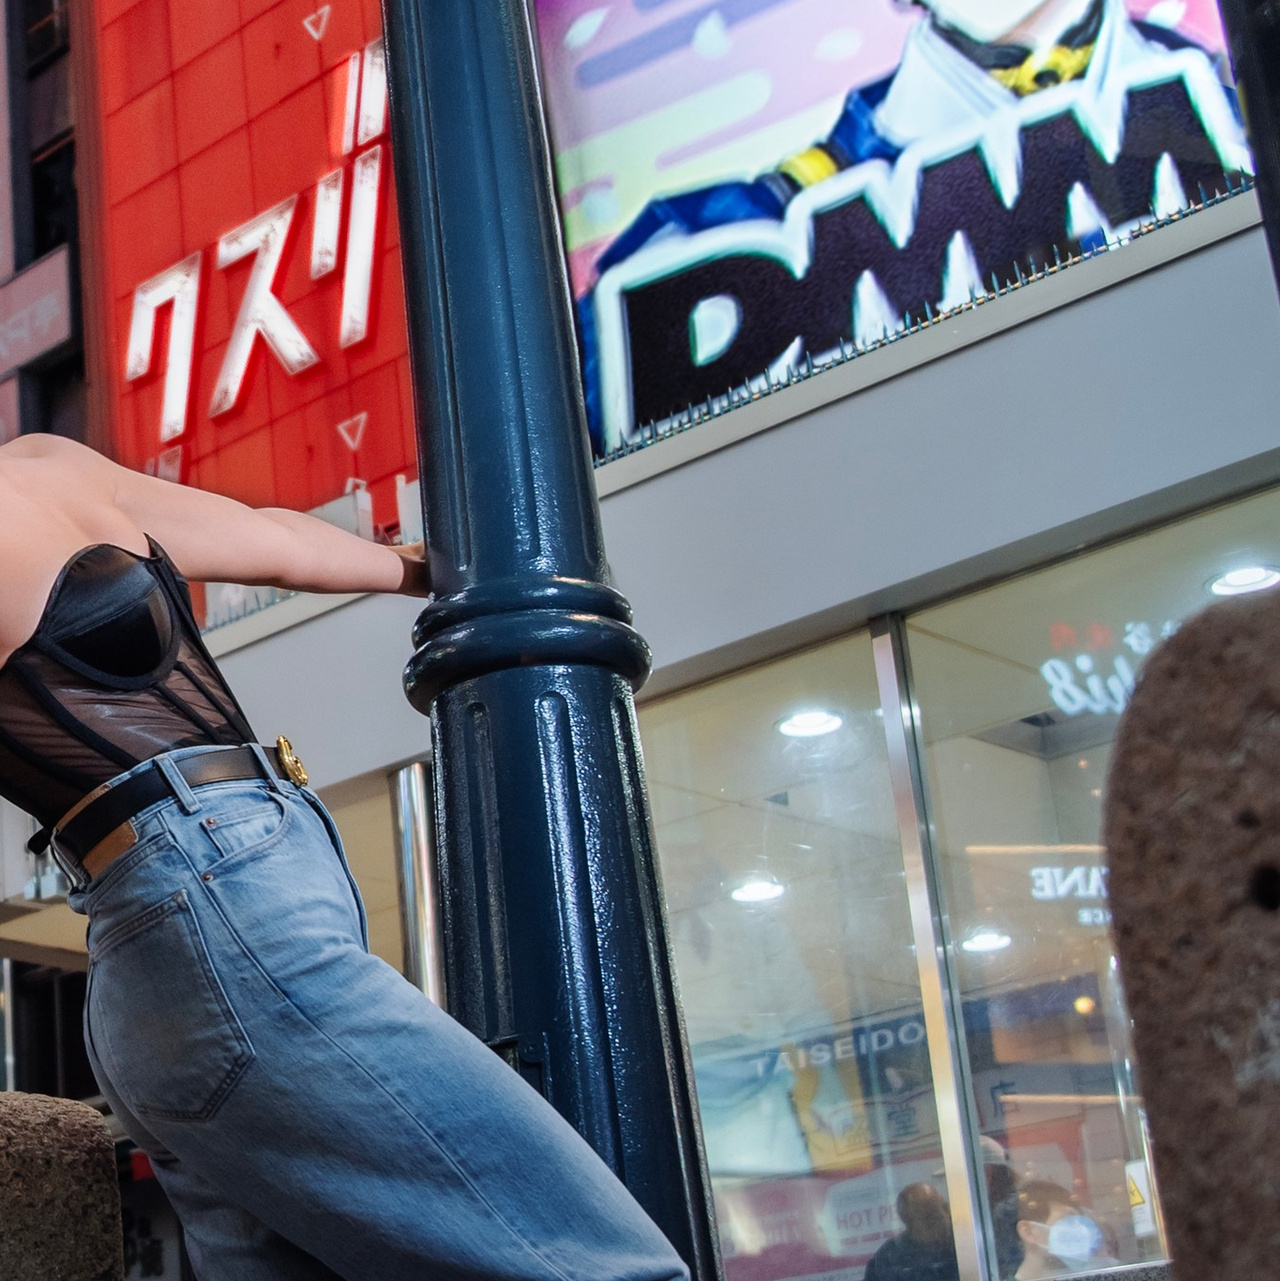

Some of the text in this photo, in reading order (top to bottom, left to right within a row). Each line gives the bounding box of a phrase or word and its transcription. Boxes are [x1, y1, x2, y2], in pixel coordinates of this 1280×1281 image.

[126, 142, 382, 444] クスリ
[755, 1021, 926, 1078] TAISEIDO
